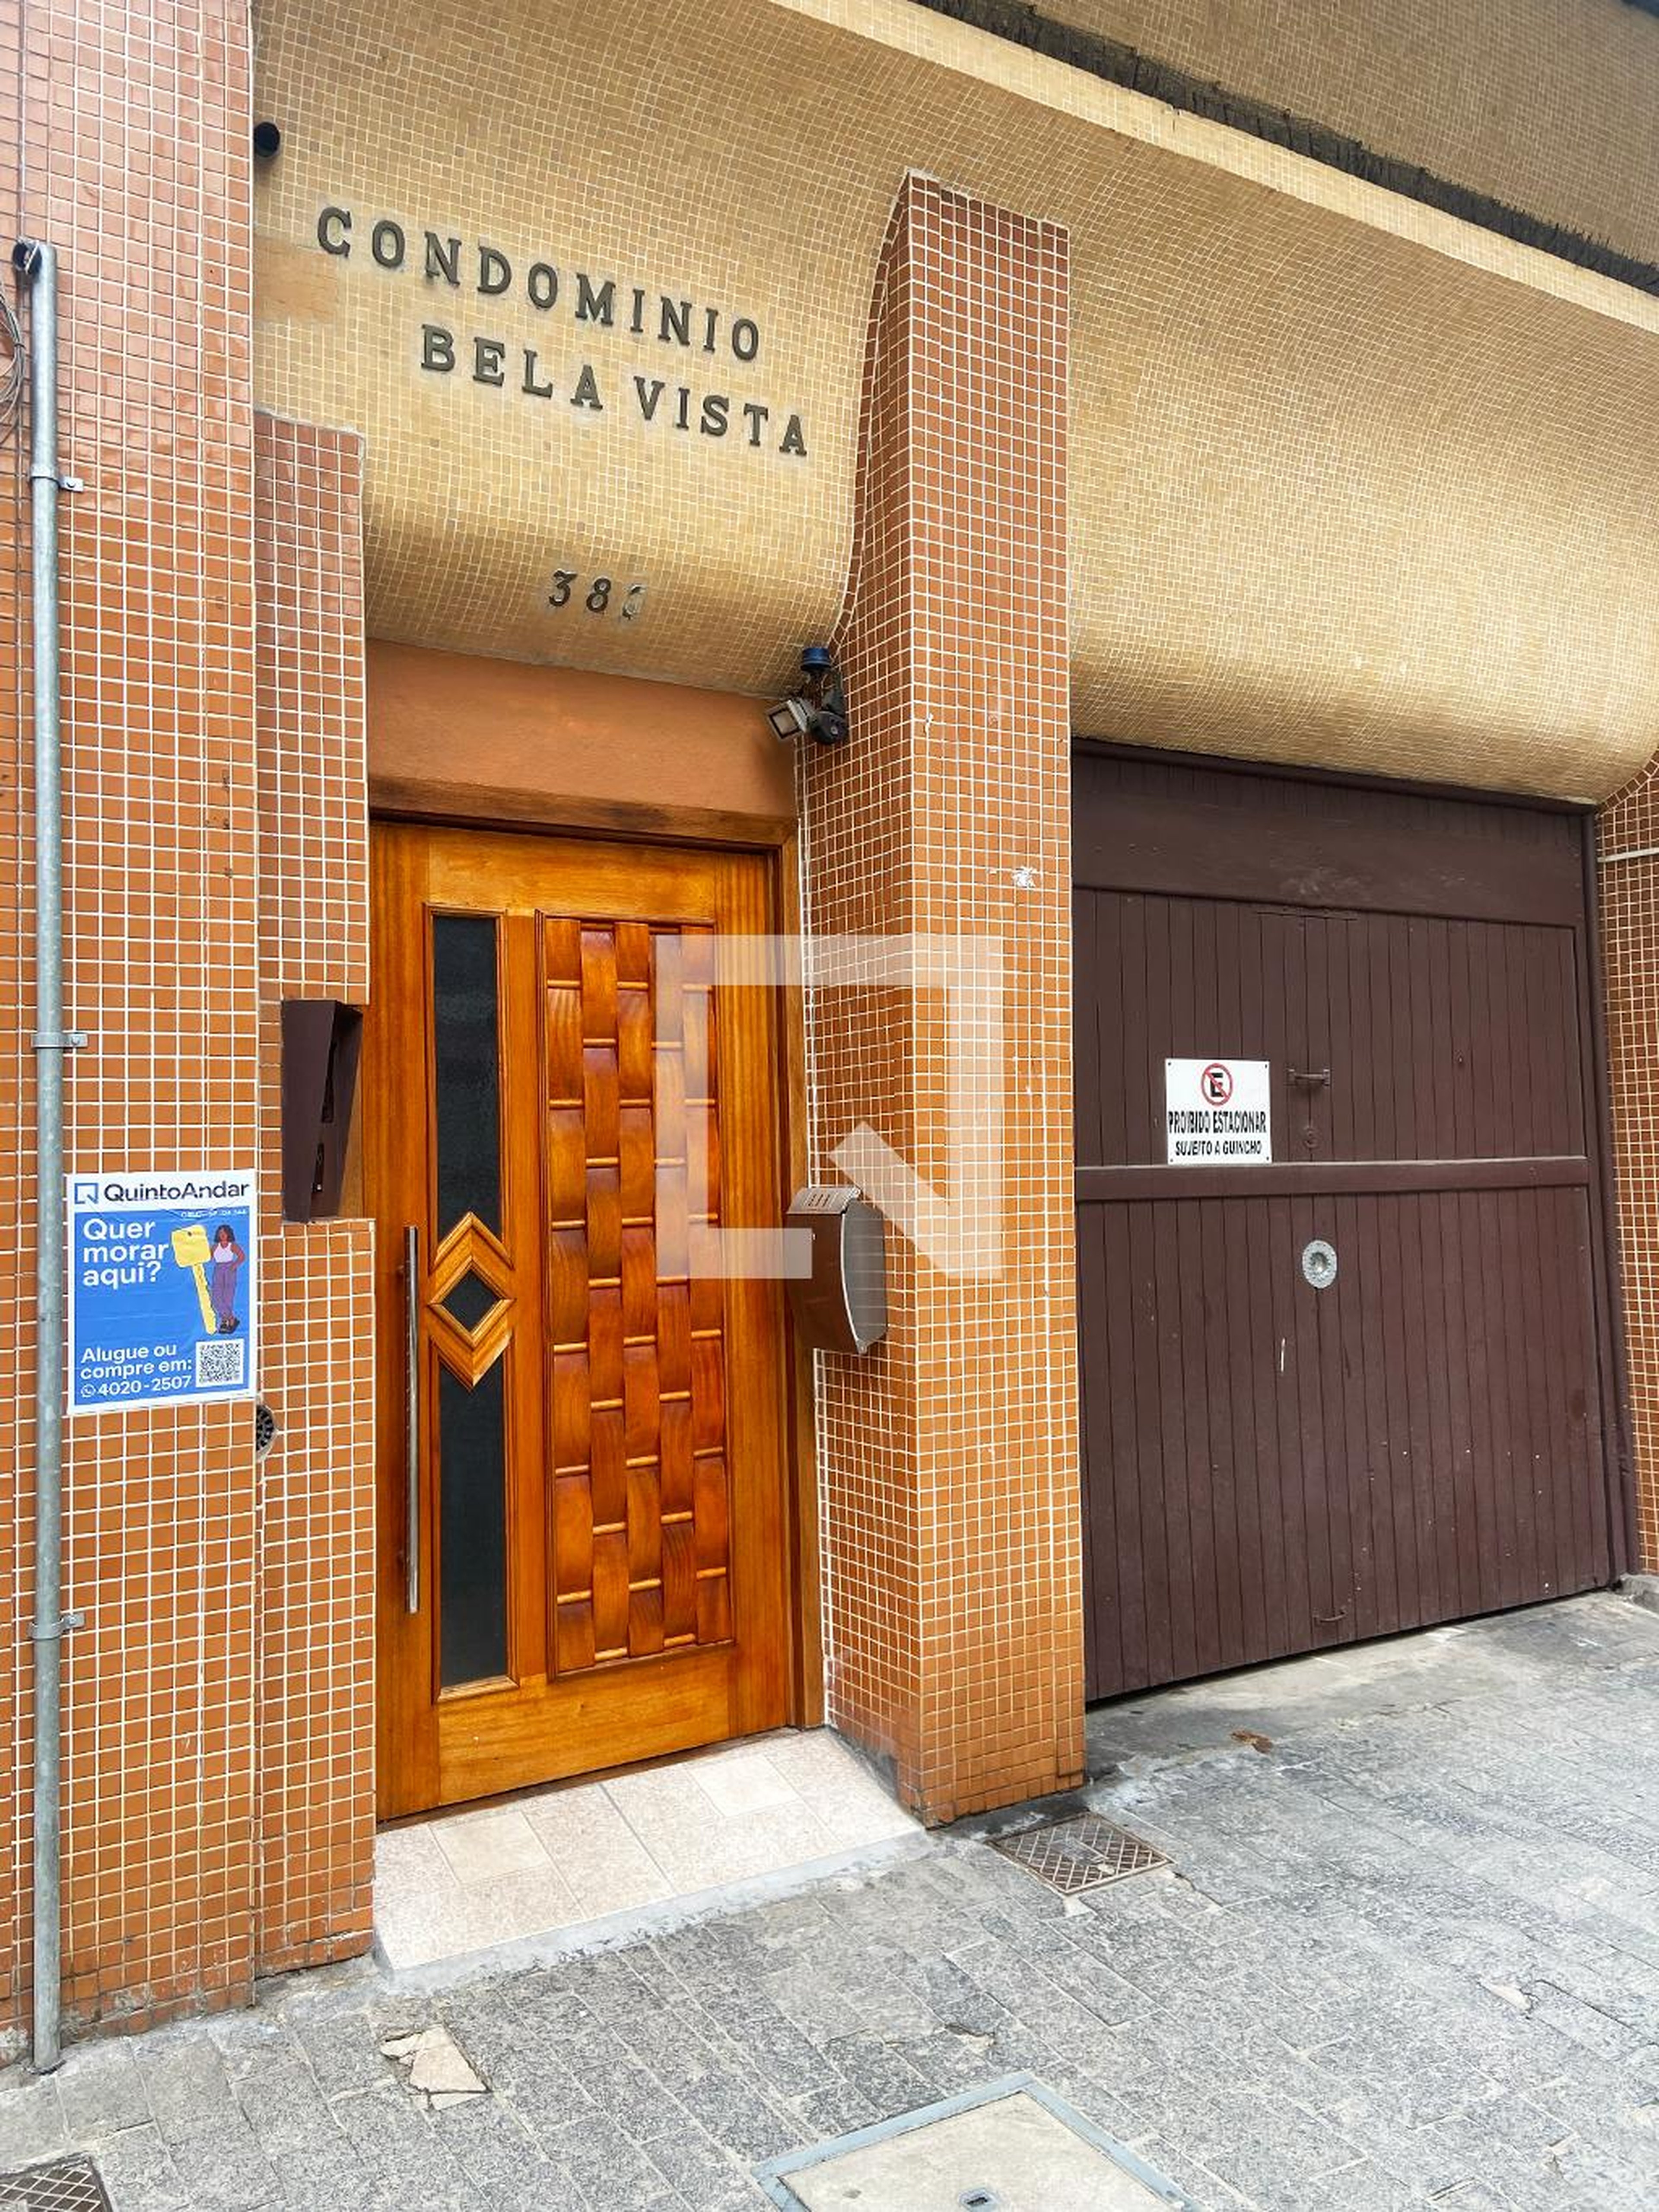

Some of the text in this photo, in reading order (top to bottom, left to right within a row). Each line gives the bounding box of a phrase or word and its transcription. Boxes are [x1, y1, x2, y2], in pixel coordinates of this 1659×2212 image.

[318, 207, 759, 361] CONDOMINIO
[421, 324, 807, 456] BELA VISTA
[1168, 1110, 1267, 1133] PROIBIDO ESTACIONAR
[1175, 1140, 1262, 1156] SUJEITO A GUINCHO
[104, 1181, 249, 1201] QuintoAndar
[83, 1219, 155, 1240] Quer
[83, 1243, 169, 1263] morar
[83, 1260, 161, 1289] aqui?
[81, 1344, 177, 1364] Alugue ou
[80, 1359, 192, 1379] compre em:
